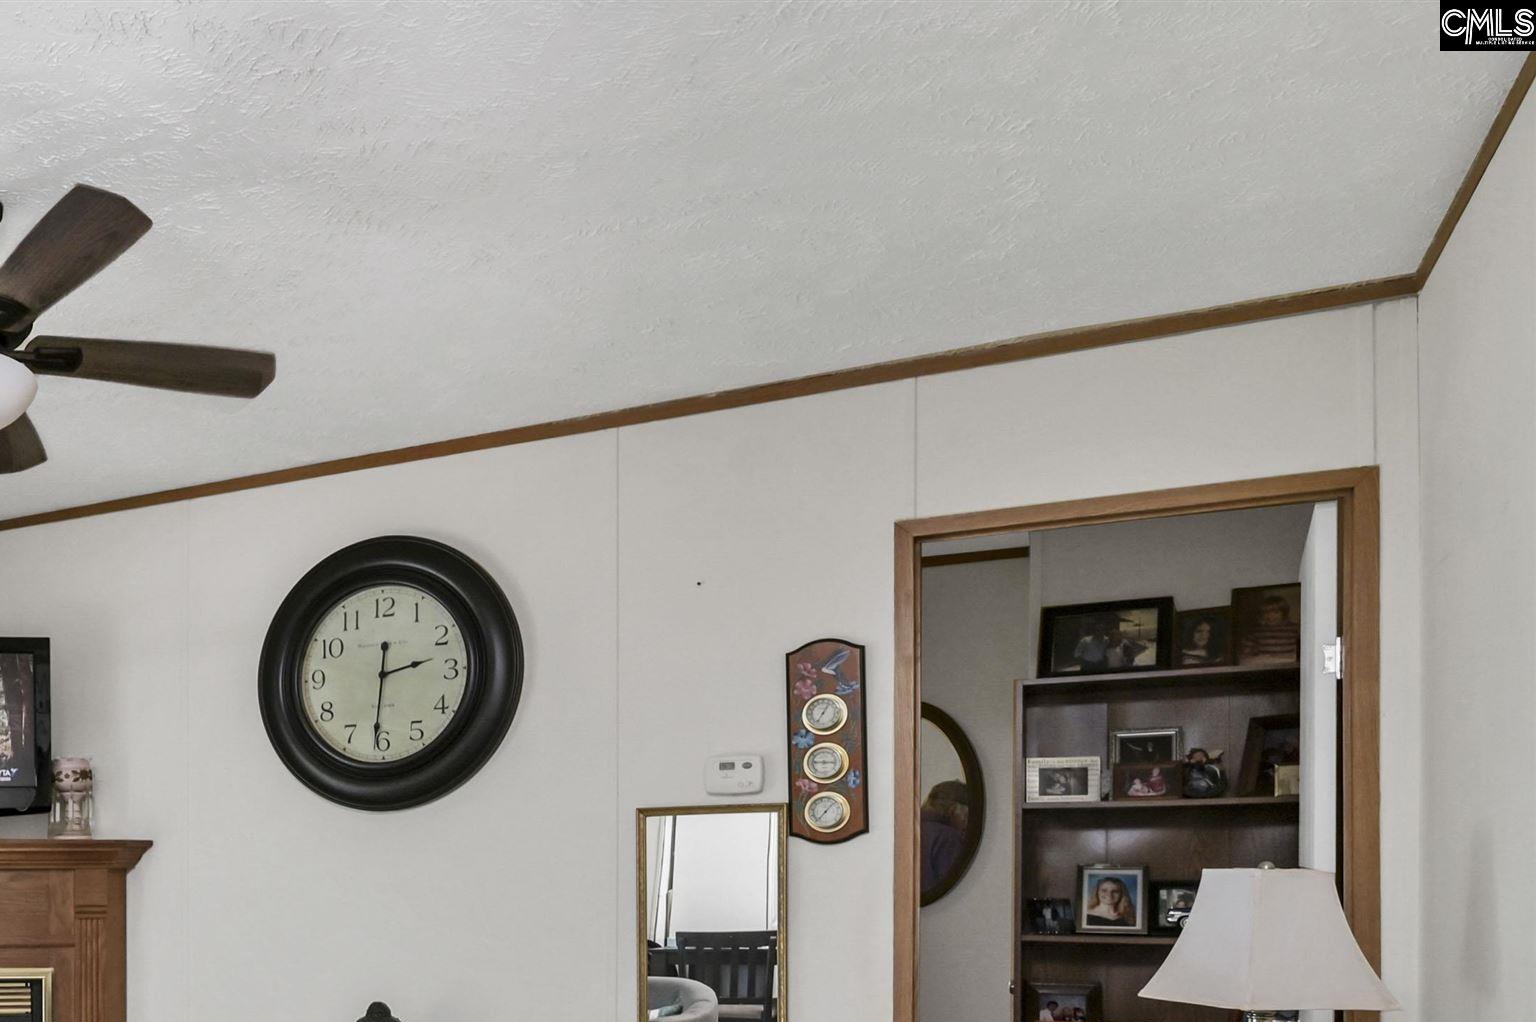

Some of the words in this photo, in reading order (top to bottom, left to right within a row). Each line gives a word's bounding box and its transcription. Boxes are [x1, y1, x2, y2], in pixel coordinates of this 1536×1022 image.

[374, 597, 396, 618] 12
[414, 602, 420, 623] 1
[343, 610, 360, 631] 11
[434, 625, 449, 646] 2
[322, 638, 344, 659] 10
[443, 658, 459, 680] 3
[311, 670, 326, 690] 9
[320, 701, 334, 722] 8
[433, 694, 449, 714] 4
[344, 724, 357, 744] 7
[409, 720, 425, 741] 5
[376, 731, 390, 752] 6
